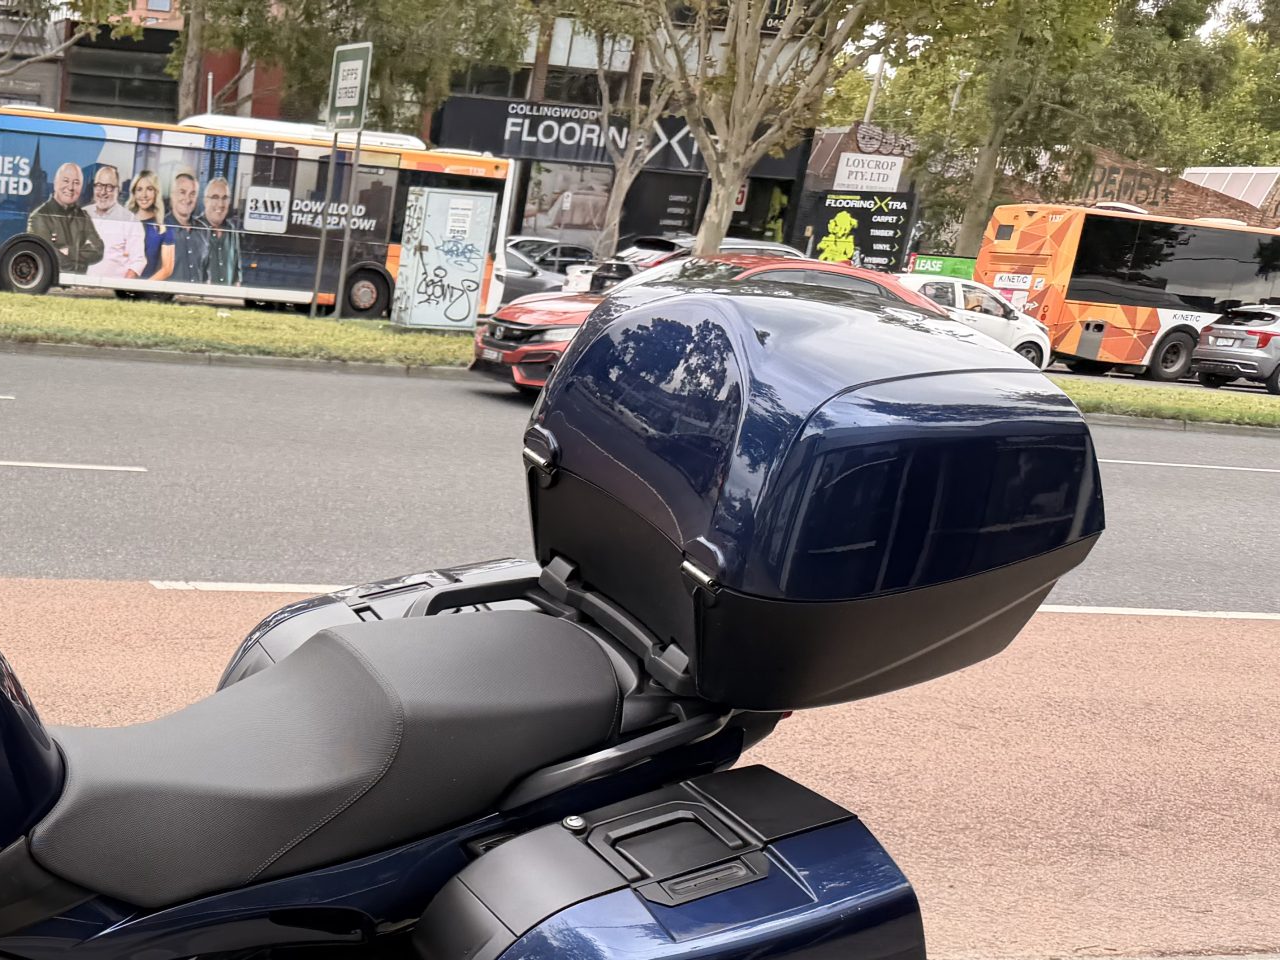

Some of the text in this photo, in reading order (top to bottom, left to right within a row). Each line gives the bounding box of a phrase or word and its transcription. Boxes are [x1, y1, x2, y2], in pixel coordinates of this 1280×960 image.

[508, 103, 598, 120] COLLINGWOOD
[845, 157, 897, 171] LOYCROP
[249, 198, 285, 214] 3AW
[291, 213, 314, 226] THE
[871, 215, 898, 224] CARPET
[915, 257, 943, 272] LEASE
